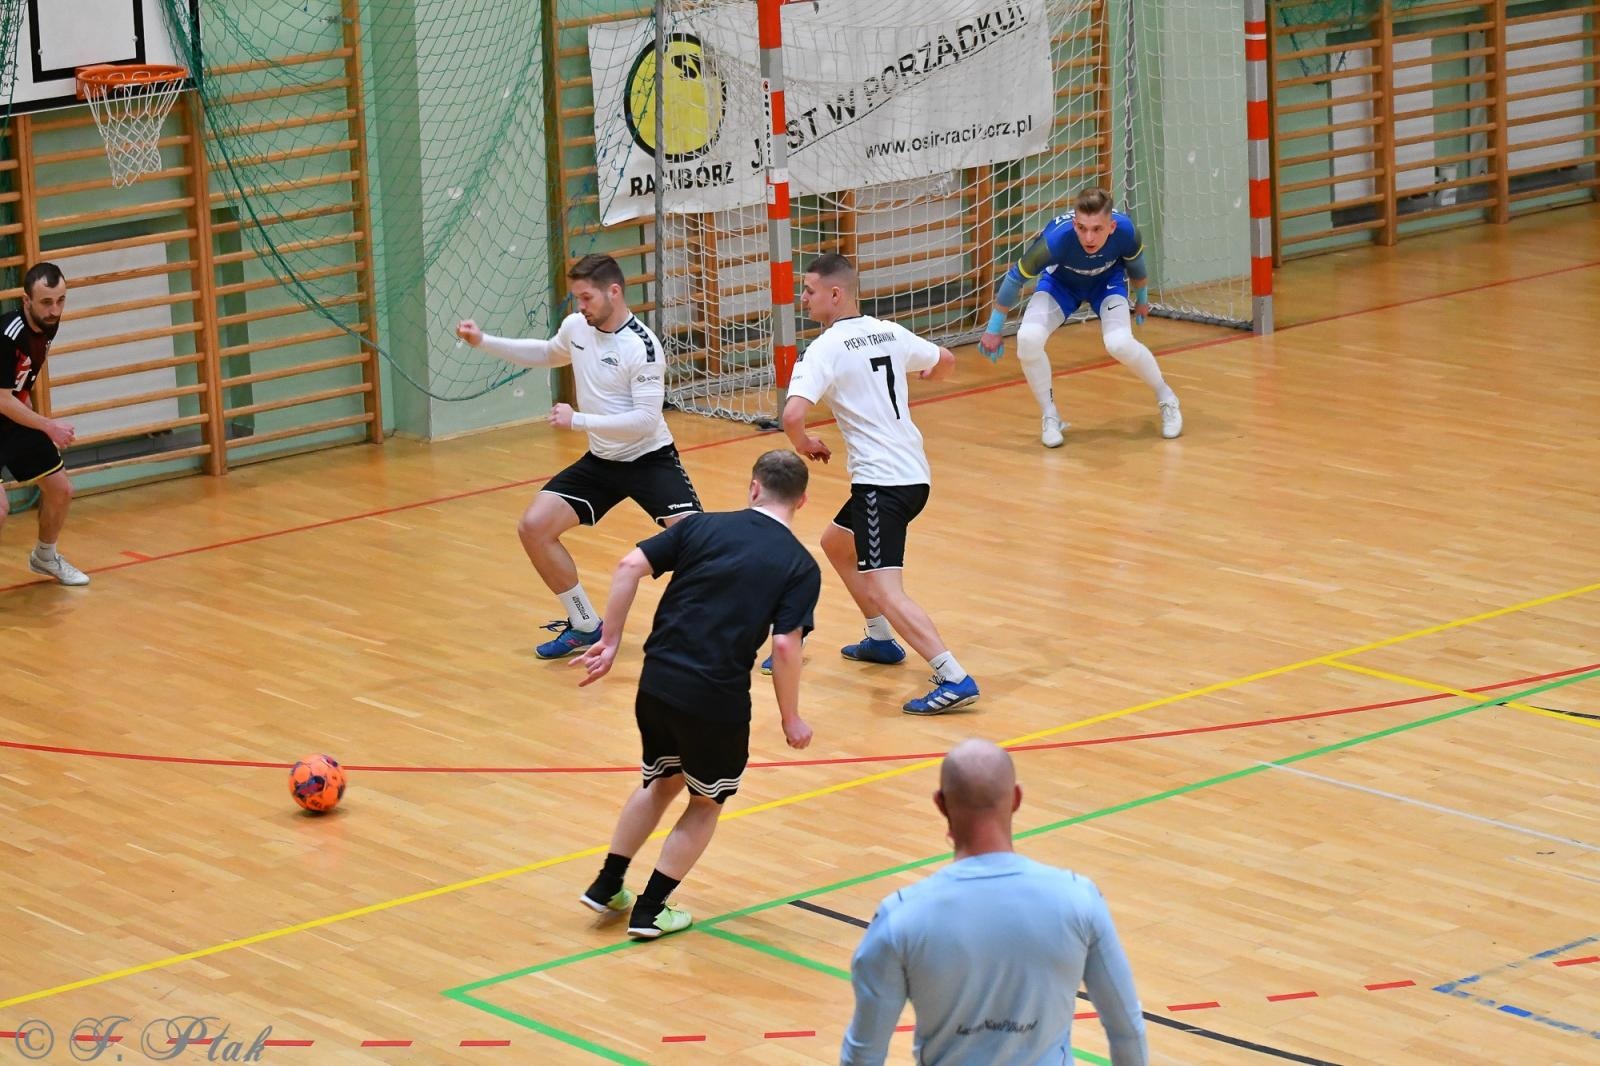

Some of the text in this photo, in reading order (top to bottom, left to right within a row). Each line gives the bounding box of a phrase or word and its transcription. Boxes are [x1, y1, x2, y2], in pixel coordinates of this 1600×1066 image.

[629, 160, 735, 197] RAIBÓRZ
[751, 106, 818, 169] JST
[825, 87, 857, 125] W
[869, 355, 901, 420] 7
